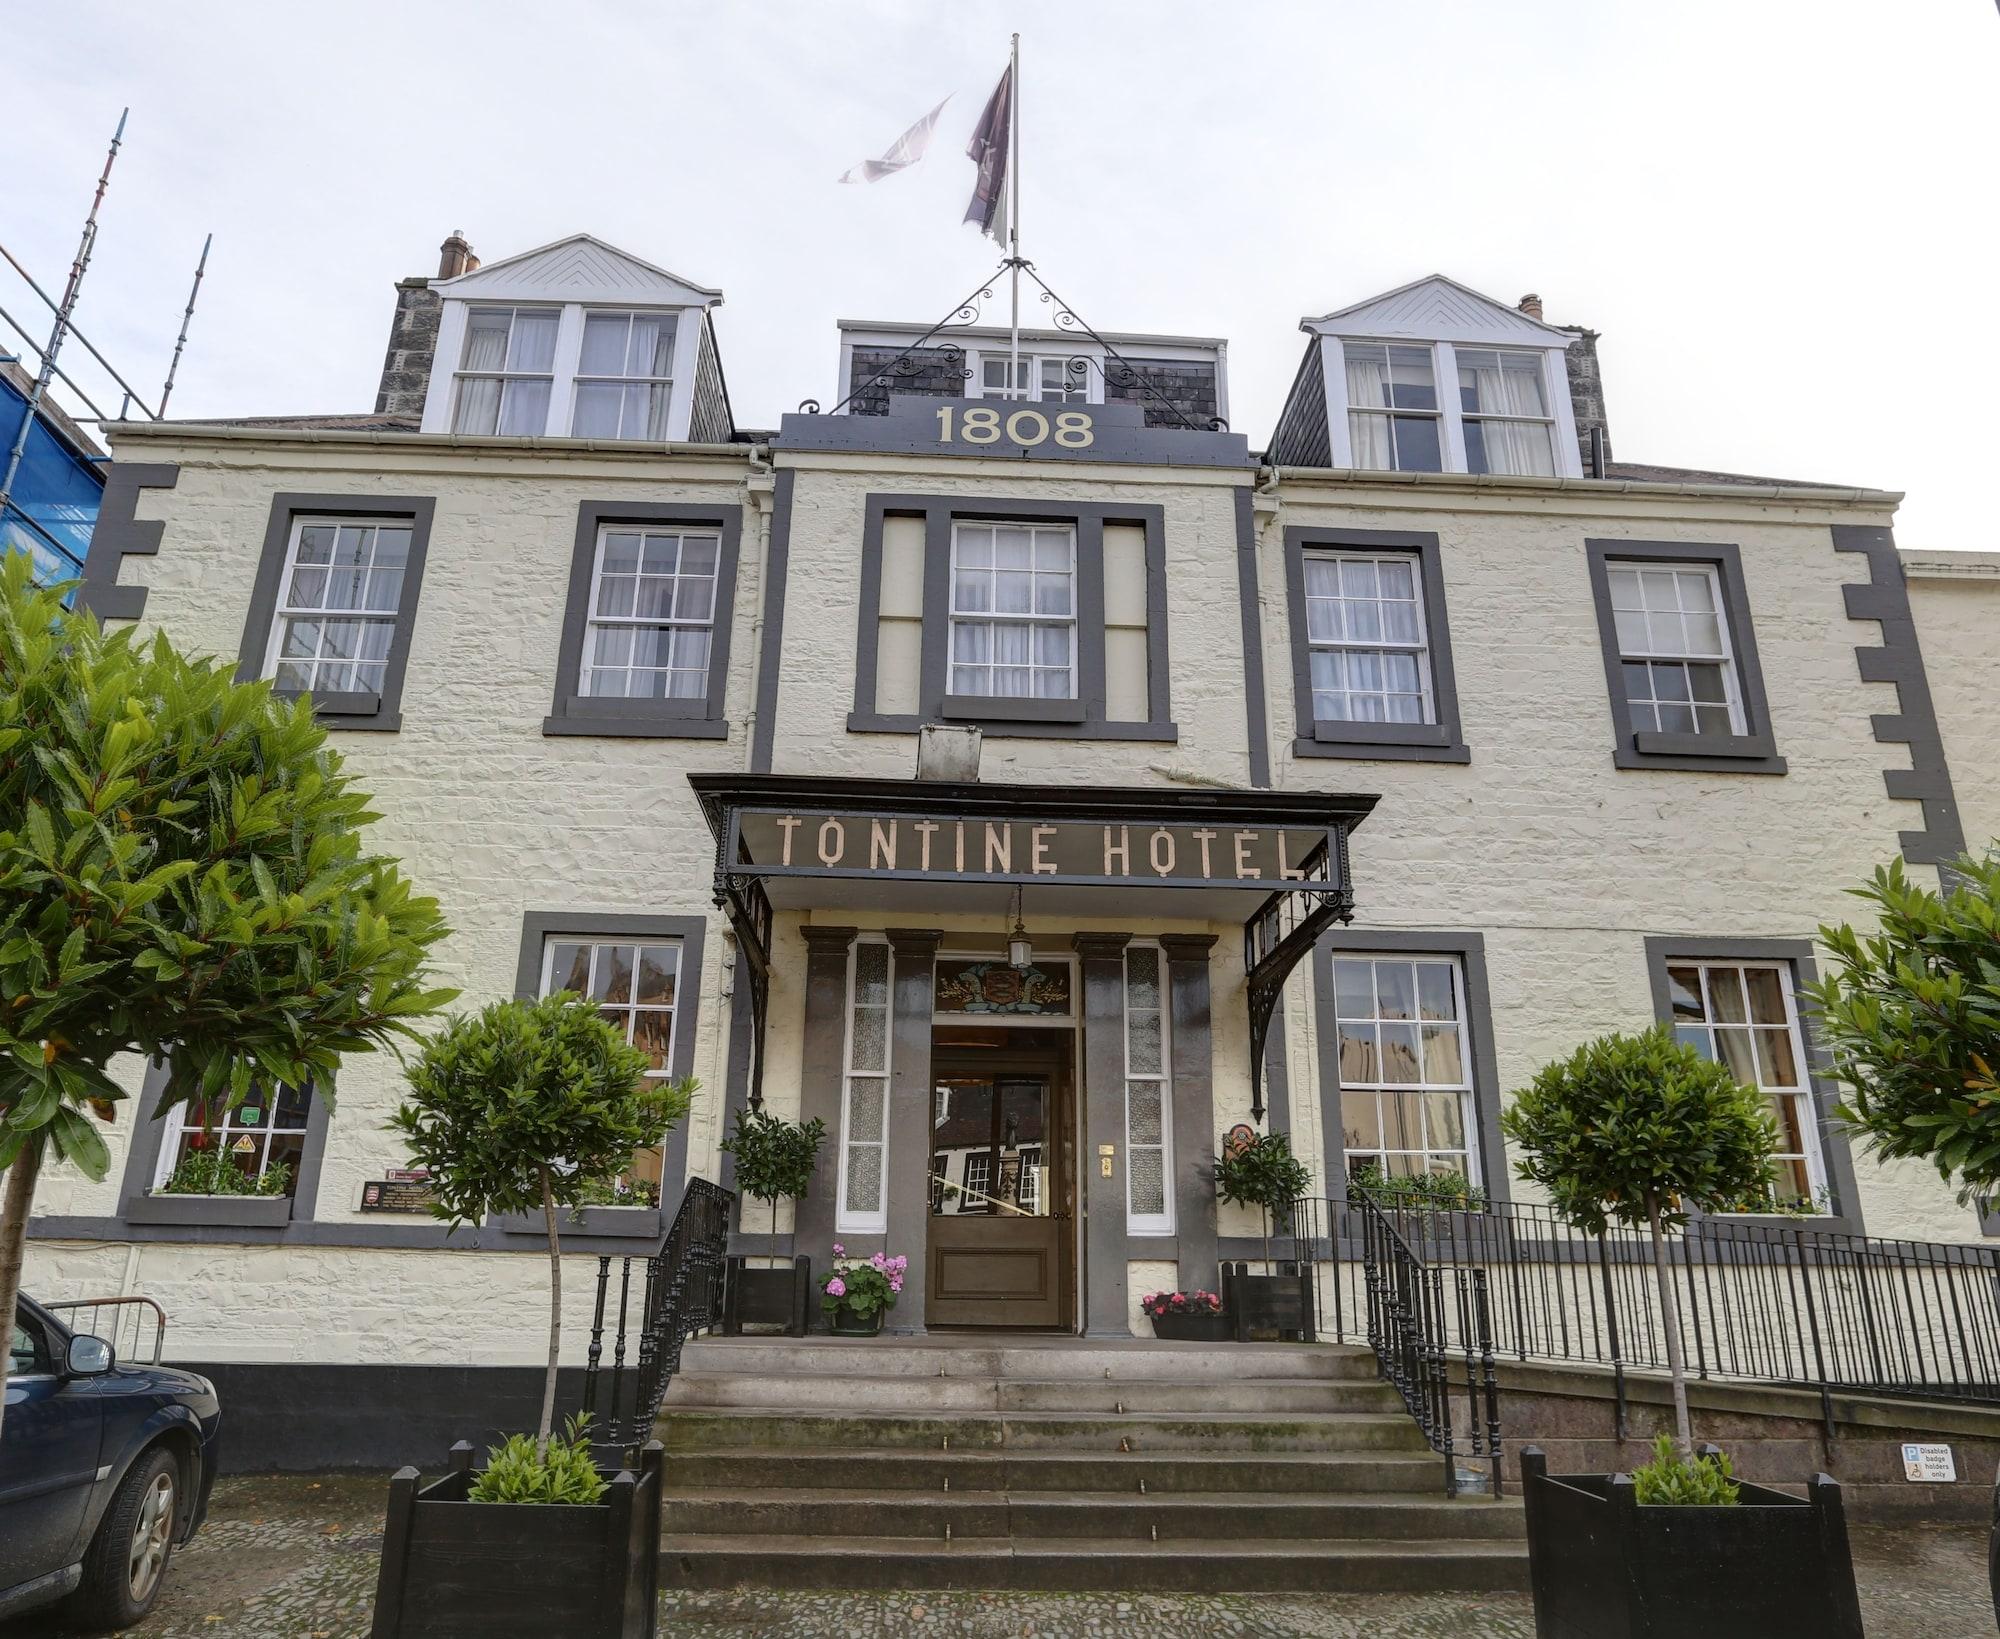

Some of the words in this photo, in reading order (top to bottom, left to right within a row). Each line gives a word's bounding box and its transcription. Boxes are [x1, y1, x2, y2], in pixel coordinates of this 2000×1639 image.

[936, 406, 1094, 448] 1808
[776, 815, 1058, 875] TONTINE
[1104, 823, 1306, 881] HOTEL
[1908, 1448, 1916, 1459] P
